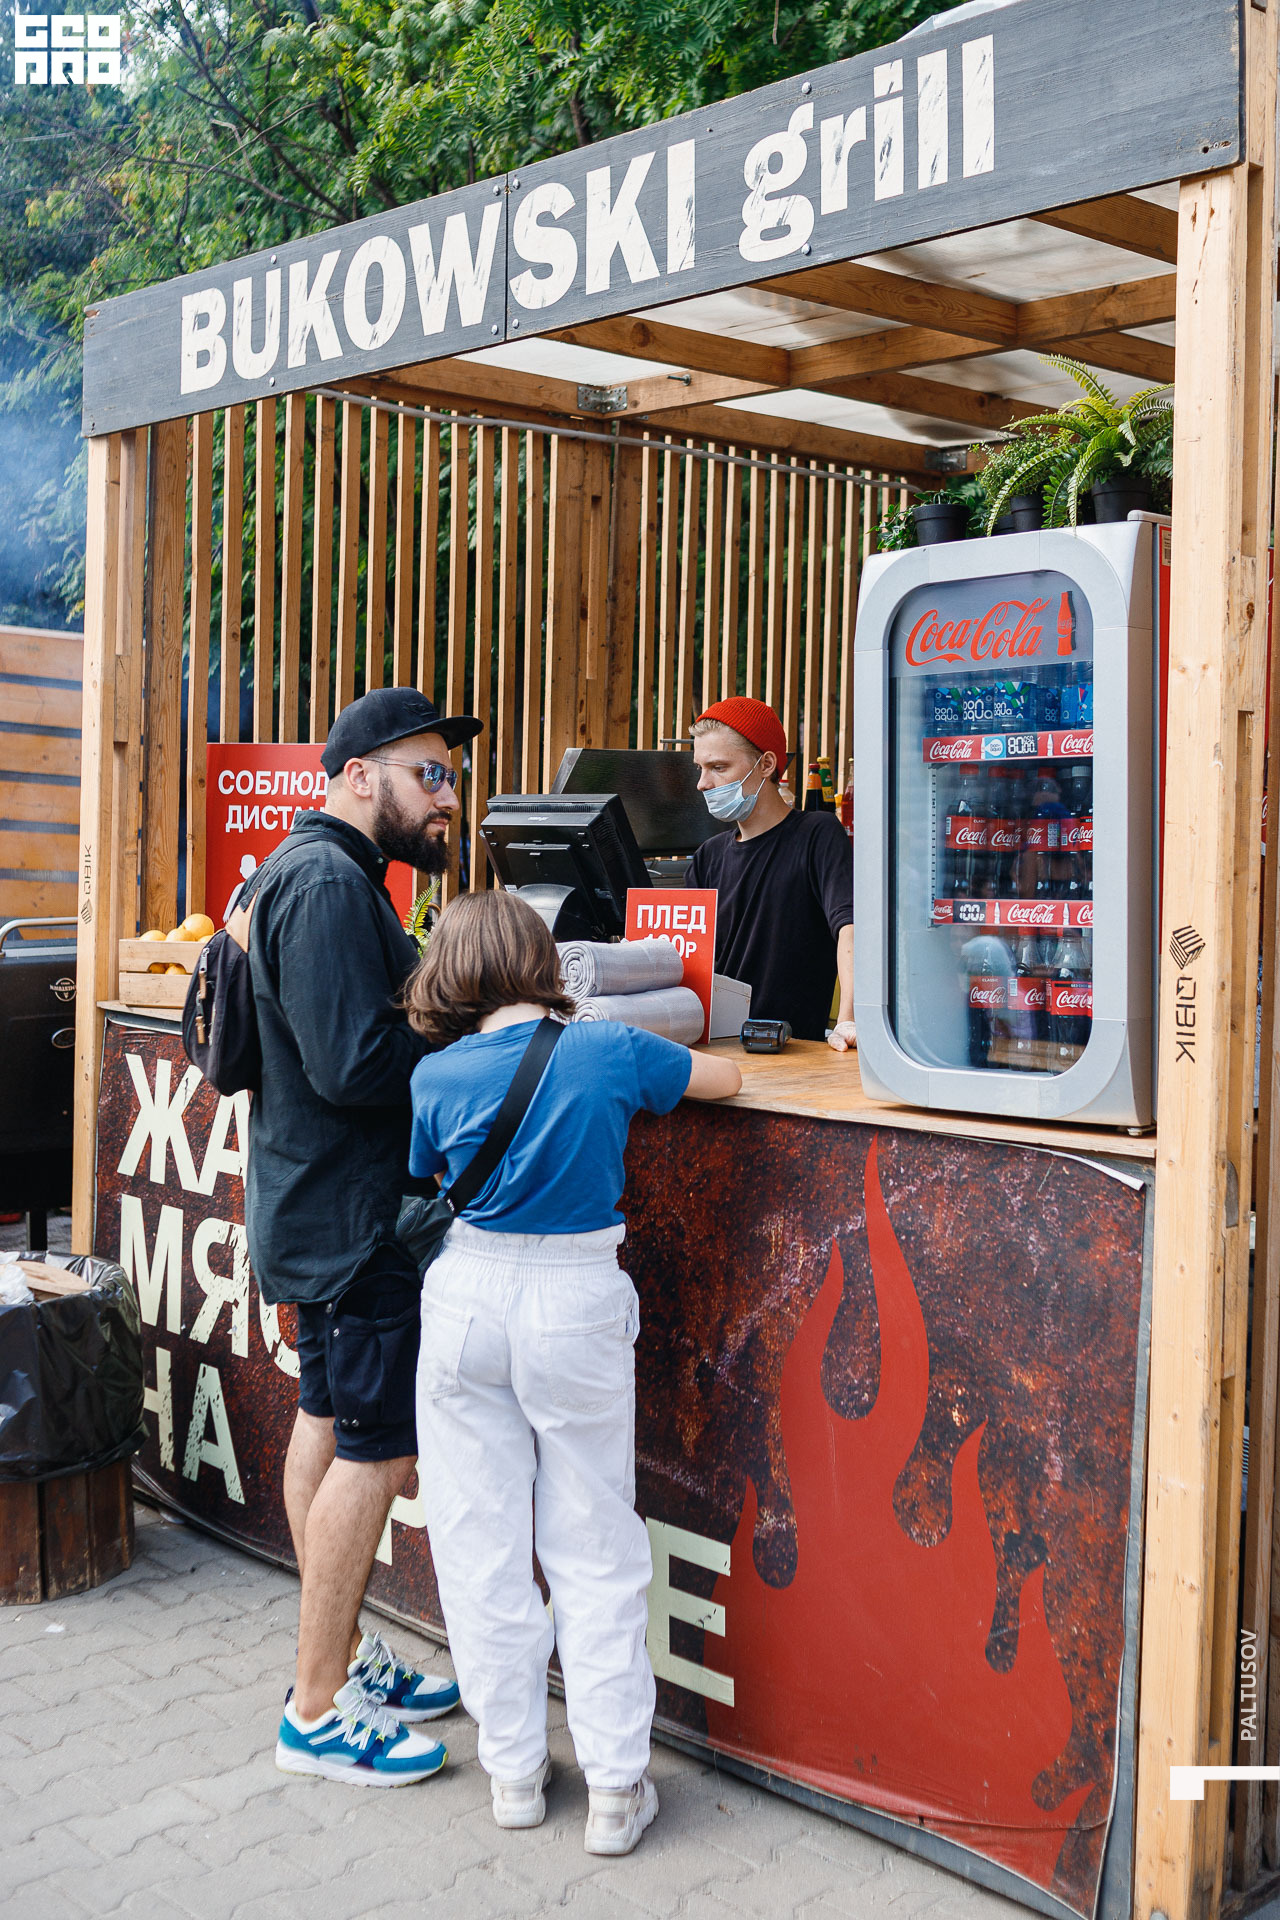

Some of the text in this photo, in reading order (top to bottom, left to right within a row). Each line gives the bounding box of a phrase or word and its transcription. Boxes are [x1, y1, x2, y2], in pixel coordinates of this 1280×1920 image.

[180, 35, 995, 395] BUKOWSKI grill
[905, 596, 1052, 666] Coca-Cola
[930, 739, 974, 760] Coca-Cola
[225, 804, 324, 833] ДИСТ
[637, 904, 706, 934] ПЛЕД
[1007, 903, 1056, 924] Coca-Cola
[1175, 976, 1197, 1064] QBIK
